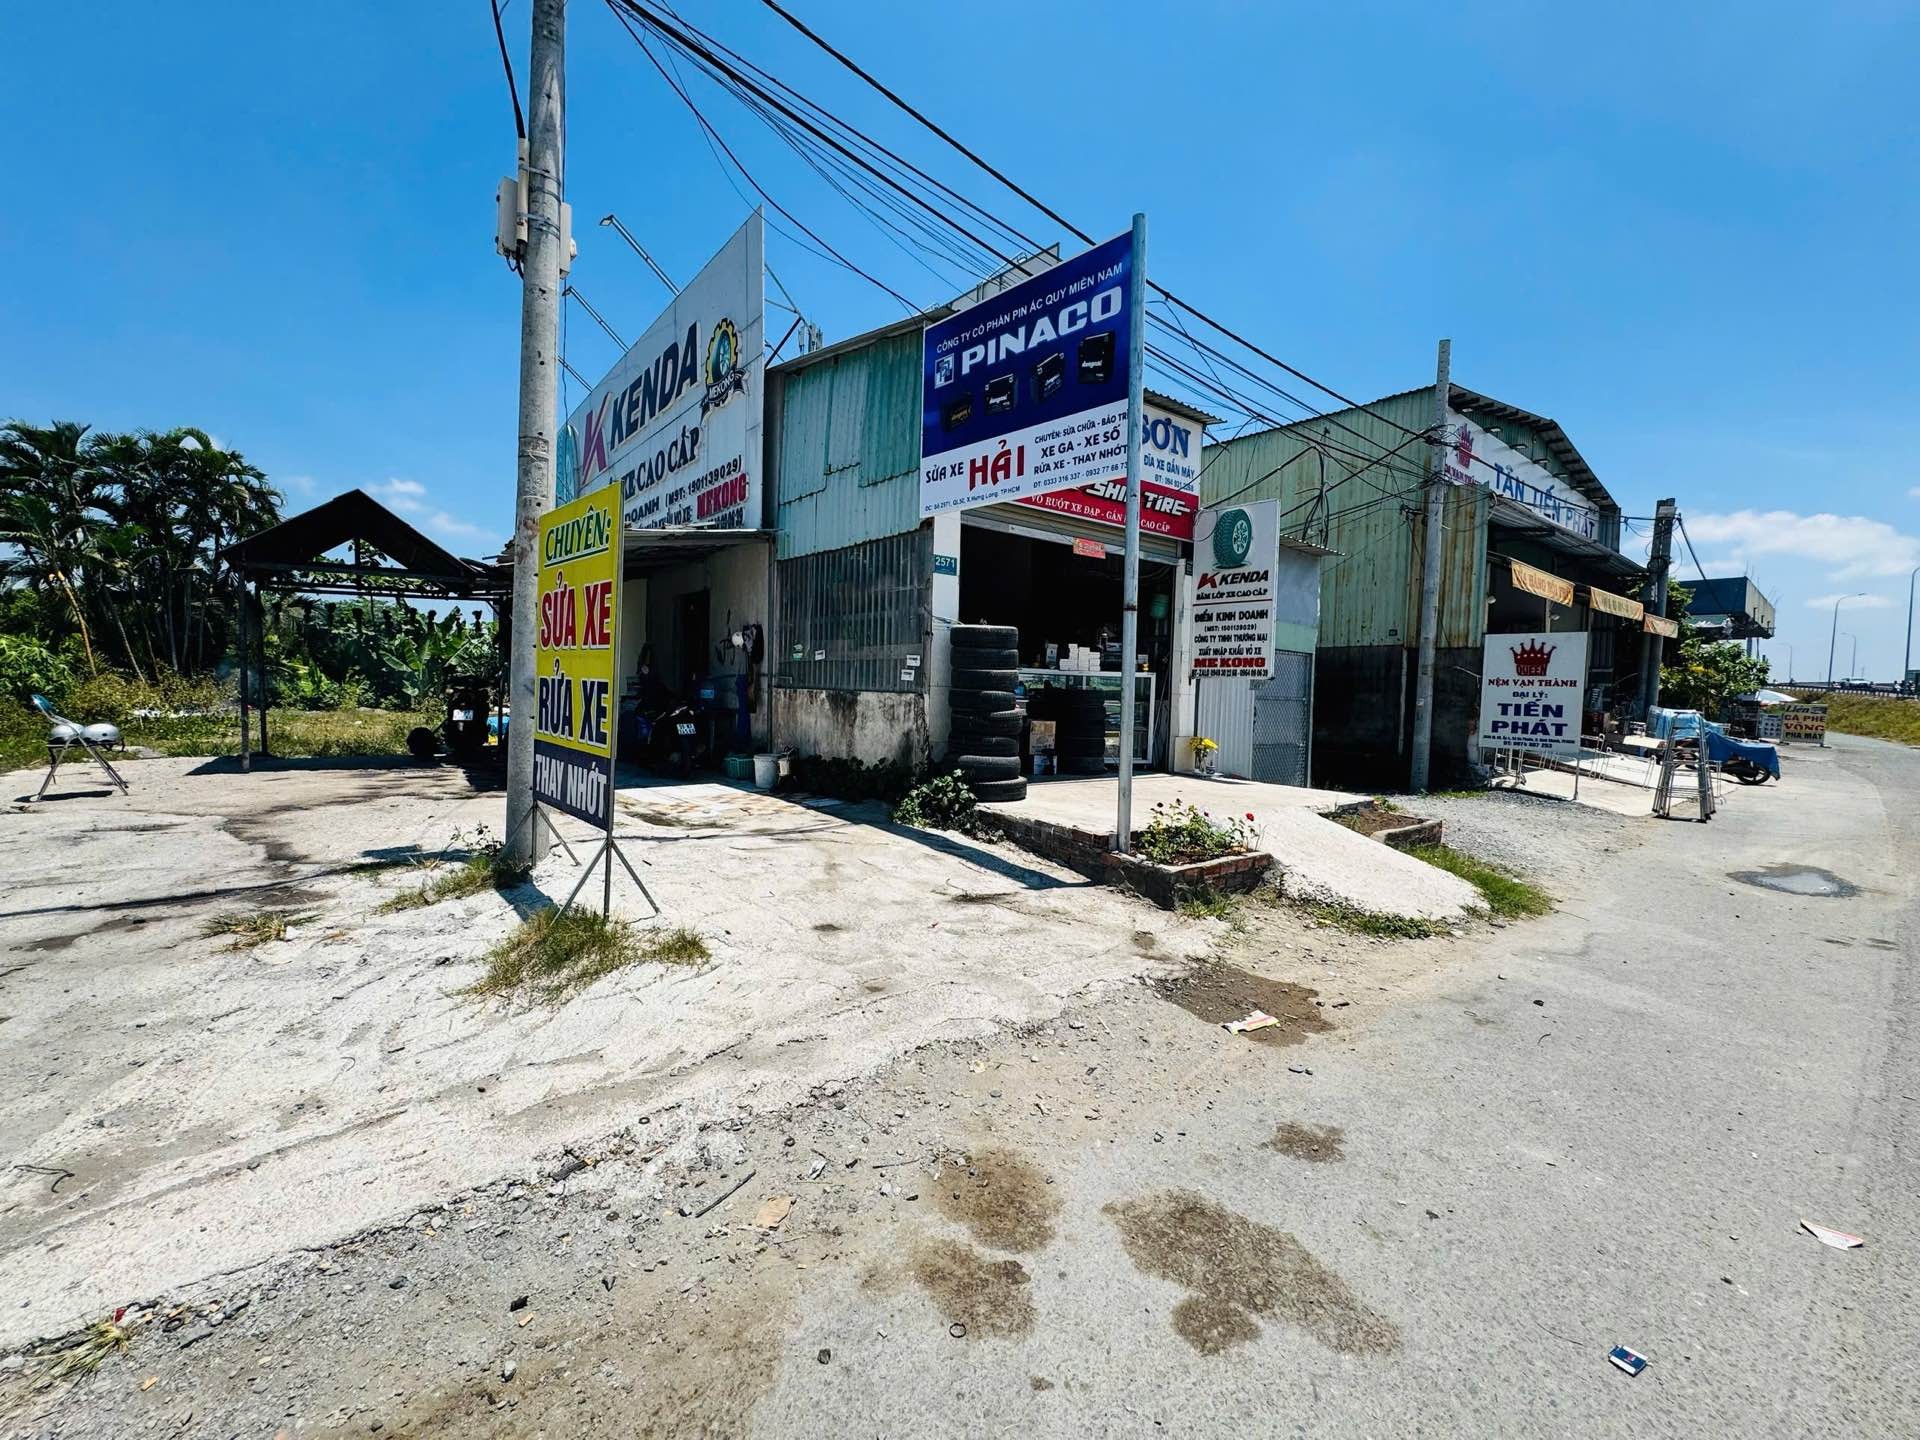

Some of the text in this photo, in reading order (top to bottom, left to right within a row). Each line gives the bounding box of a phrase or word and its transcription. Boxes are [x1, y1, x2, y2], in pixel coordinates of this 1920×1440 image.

[960, 331, 971, 343] TY
[1012, 304, 1028, 321] PIN
[1045, 287, 1067, 306] QUY
[1097, 262, 1123, 283] NAM
[961, 286, 1122, 375] PINACO
[610, 320, 699, 451] KENDA
[1041, 424, 1121, 459] XE GA XE SỐ
[1142, 413, 1191, 458] SƠN
[637, 450, 666, 491] CAO
[667, 425, 700, 473] CẤP
[926, 439, 1025, 492] SỬA XE HẢI
[1033, 443, 1128, 475] RỬA XE THAY NHỚT
[1043, 477, 1057, 487] 0333
[1085, 467, 1100, 478] 0932
[1101, 465, 1110, 474] 77
[1110, 463, 1119, 472] 66
[625, 496, 660, 523] DOANH
[1086, 482, 1127, 503] SHI
[1494, 462, 1595, 539] TÂN TIẾN PHÁT
[545, 504, 612, 562] CHUYÊN:
[1045, 496, 1069, 510] RUỘT
[1070, 502, 1083, 513] XE
[1083, 505, 1101, 517] ĐẠP
[1140, 519, 1156, 529] CAO
[1156, 517, 1171, 533] CẤP
[935, 556, 955, 569] 2571
[1219, 570, 1269, 586] KENDA
[540, 570, 612, 649] SỬA XE
[1215, 610, 1236, 622] KINH
[1238, 609, 1268, 620] DOANH
[1488, 677, 1578, 688] NỆM VẠN THÀNH
[537, 658, 608, 746] RỬA XE
[1497, 699, 1564, 718] TIẾN
[1491, 719, 1568, 736] PHÁT
[535, 754, 607, 818] THAY NHỚT
